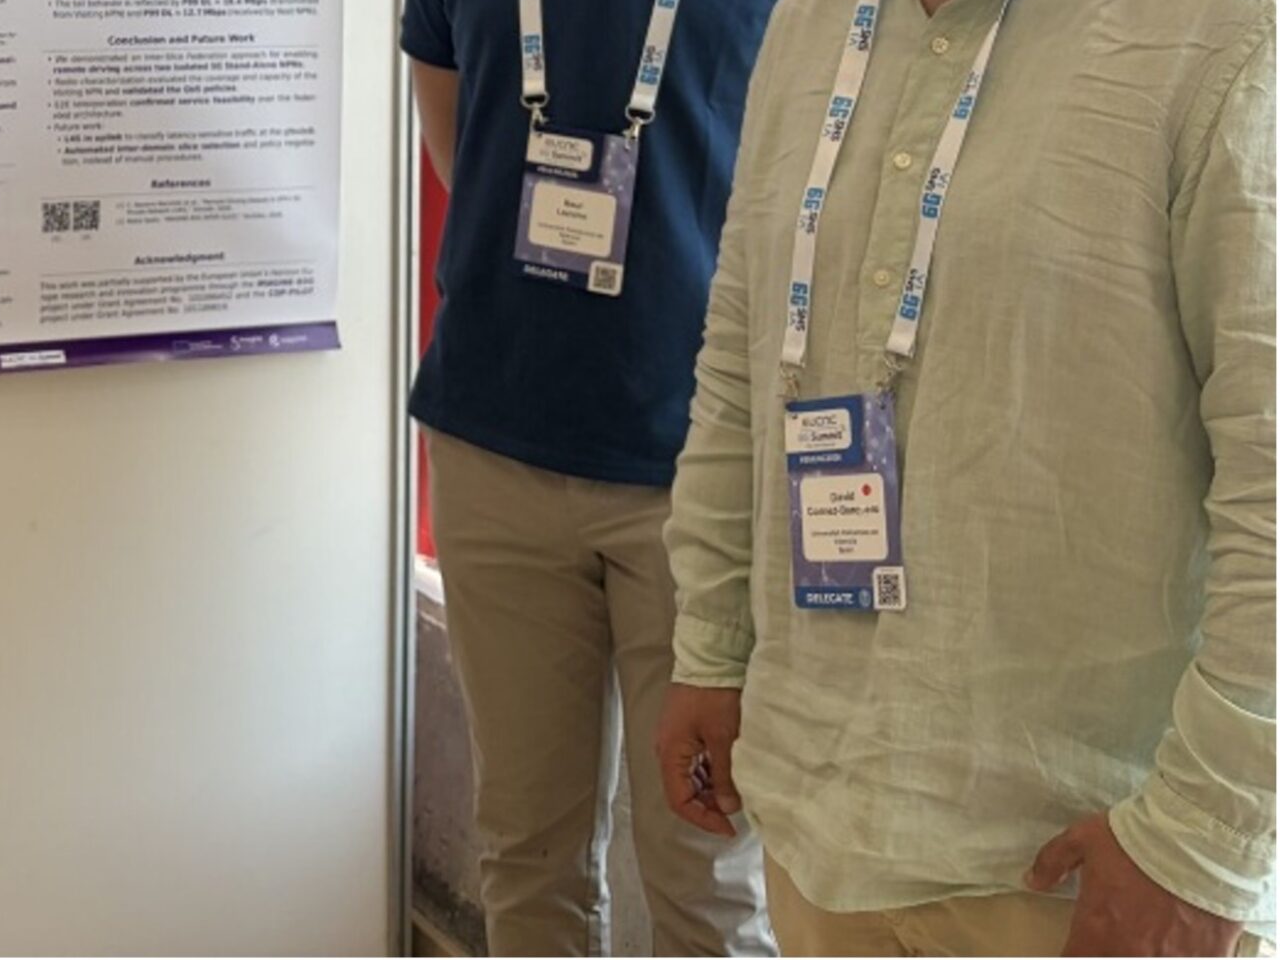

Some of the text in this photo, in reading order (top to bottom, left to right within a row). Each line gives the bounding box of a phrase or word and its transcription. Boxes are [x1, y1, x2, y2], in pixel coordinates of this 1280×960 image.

[854, 4, 876, 29] 6G
[107, 31, 255, 47] Conclusion and Future Work
[827, 95, 853, 119] 6G
[151, 178, 212, 189] References
[803, 186, 825, 210] 6G
[921, 191, 942, 219] 6G
[134, 251, 225, 266] Acknowledgment
[790, 282, 809, 307] 6G
[899, 292, 921, 321] 6G
[806, 592, 856, 605] DELEGATE
